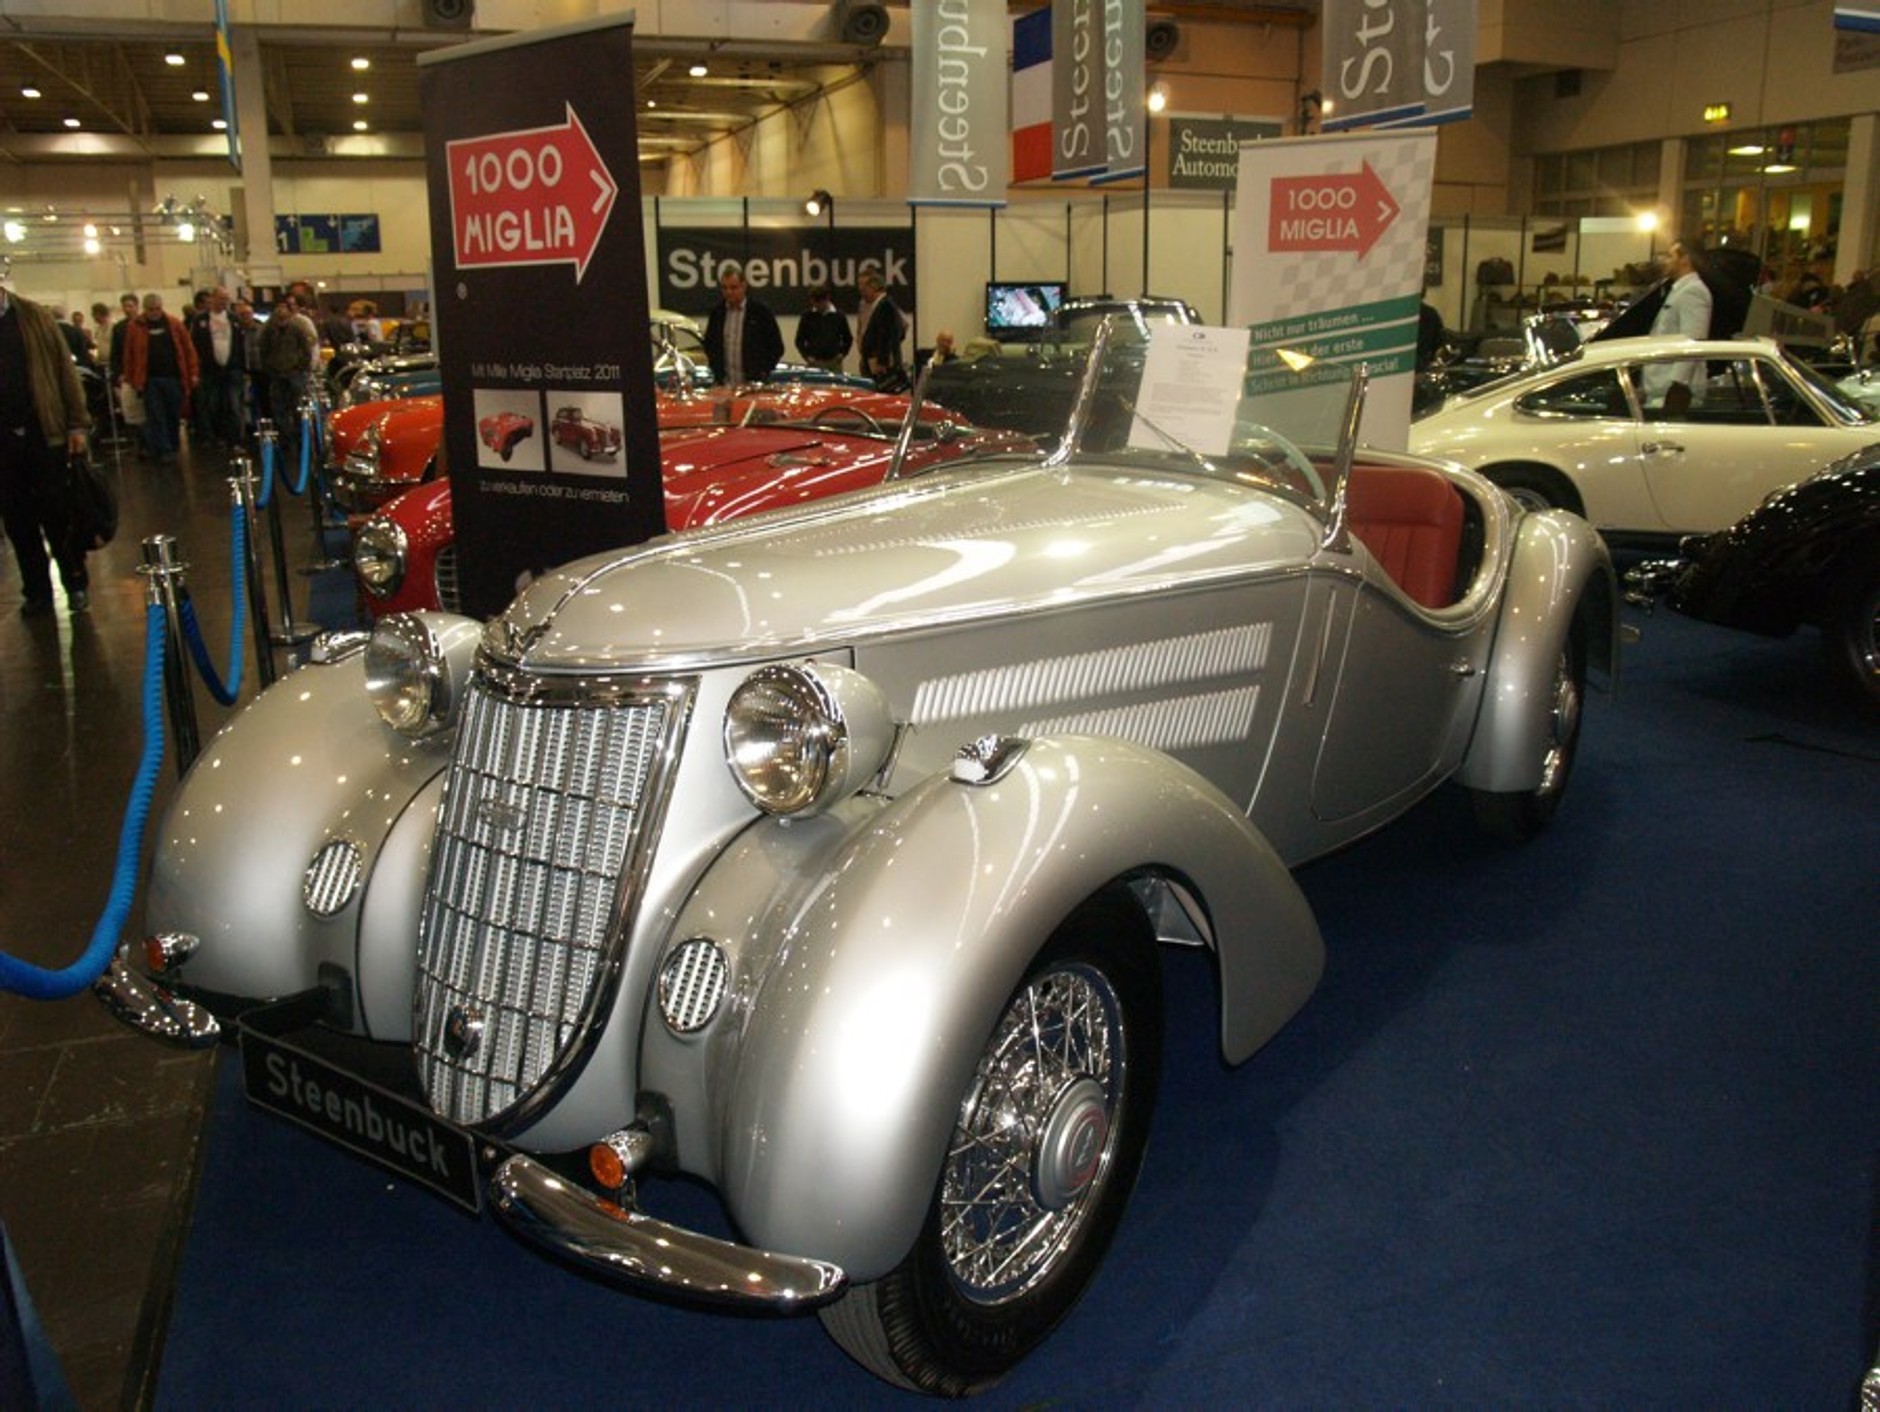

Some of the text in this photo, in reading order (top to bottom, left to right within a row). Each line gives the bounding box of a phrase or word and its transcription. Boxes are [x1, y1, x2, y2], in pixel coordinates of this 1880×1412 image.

[1062, 0, 1091, 159] Steen
[1180, 128, 1238, 154] Steenb
[465, 144, 563, 195] 1000
[1288, 187, 1357, 211] 1000
[464, 204, 576, 254] MIGLIA
[1280, 218, 1360, 242] MIGLIA
[1333, 338, 1364, 353] erste
[265, 1051, 450, 1178] Steenbuck
